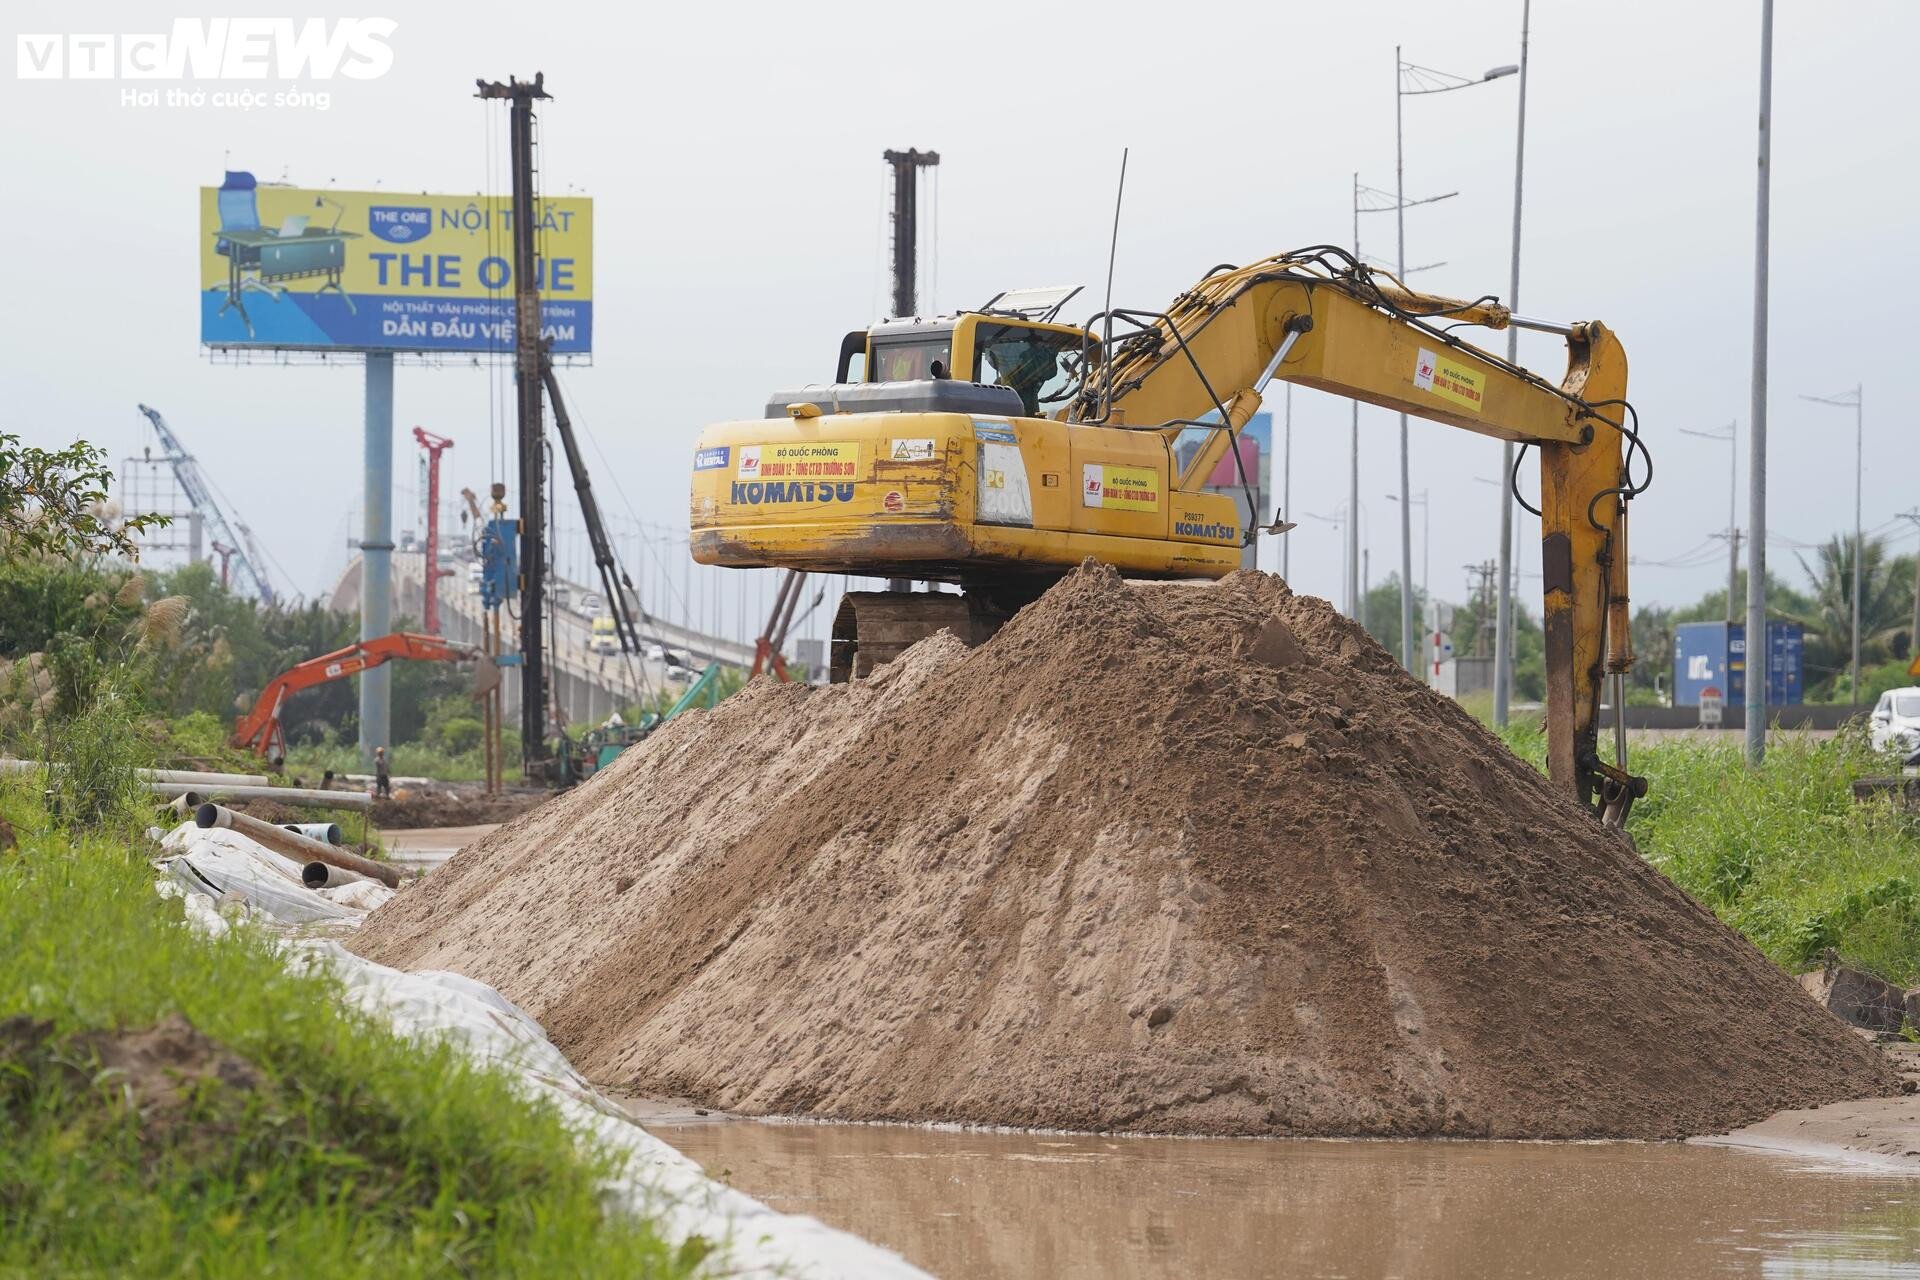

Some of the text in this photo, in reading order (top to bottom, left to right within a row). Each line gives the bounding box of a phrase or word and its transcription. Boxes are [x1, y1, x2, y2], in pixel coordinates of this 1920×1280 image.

[374, 211, 427, 224] THE ONE
[441, 203, 575, 236] NỘI TẤT
[369, 253, 461, 288] THE
[383, 315, 427, 337] DẪN
[777, 445, 839, 459] BỘ QUỐC PHÒNG
[731, 480, 854, 504] KOMATSU
[1175, 522, 1234, 539] KOMATSU
